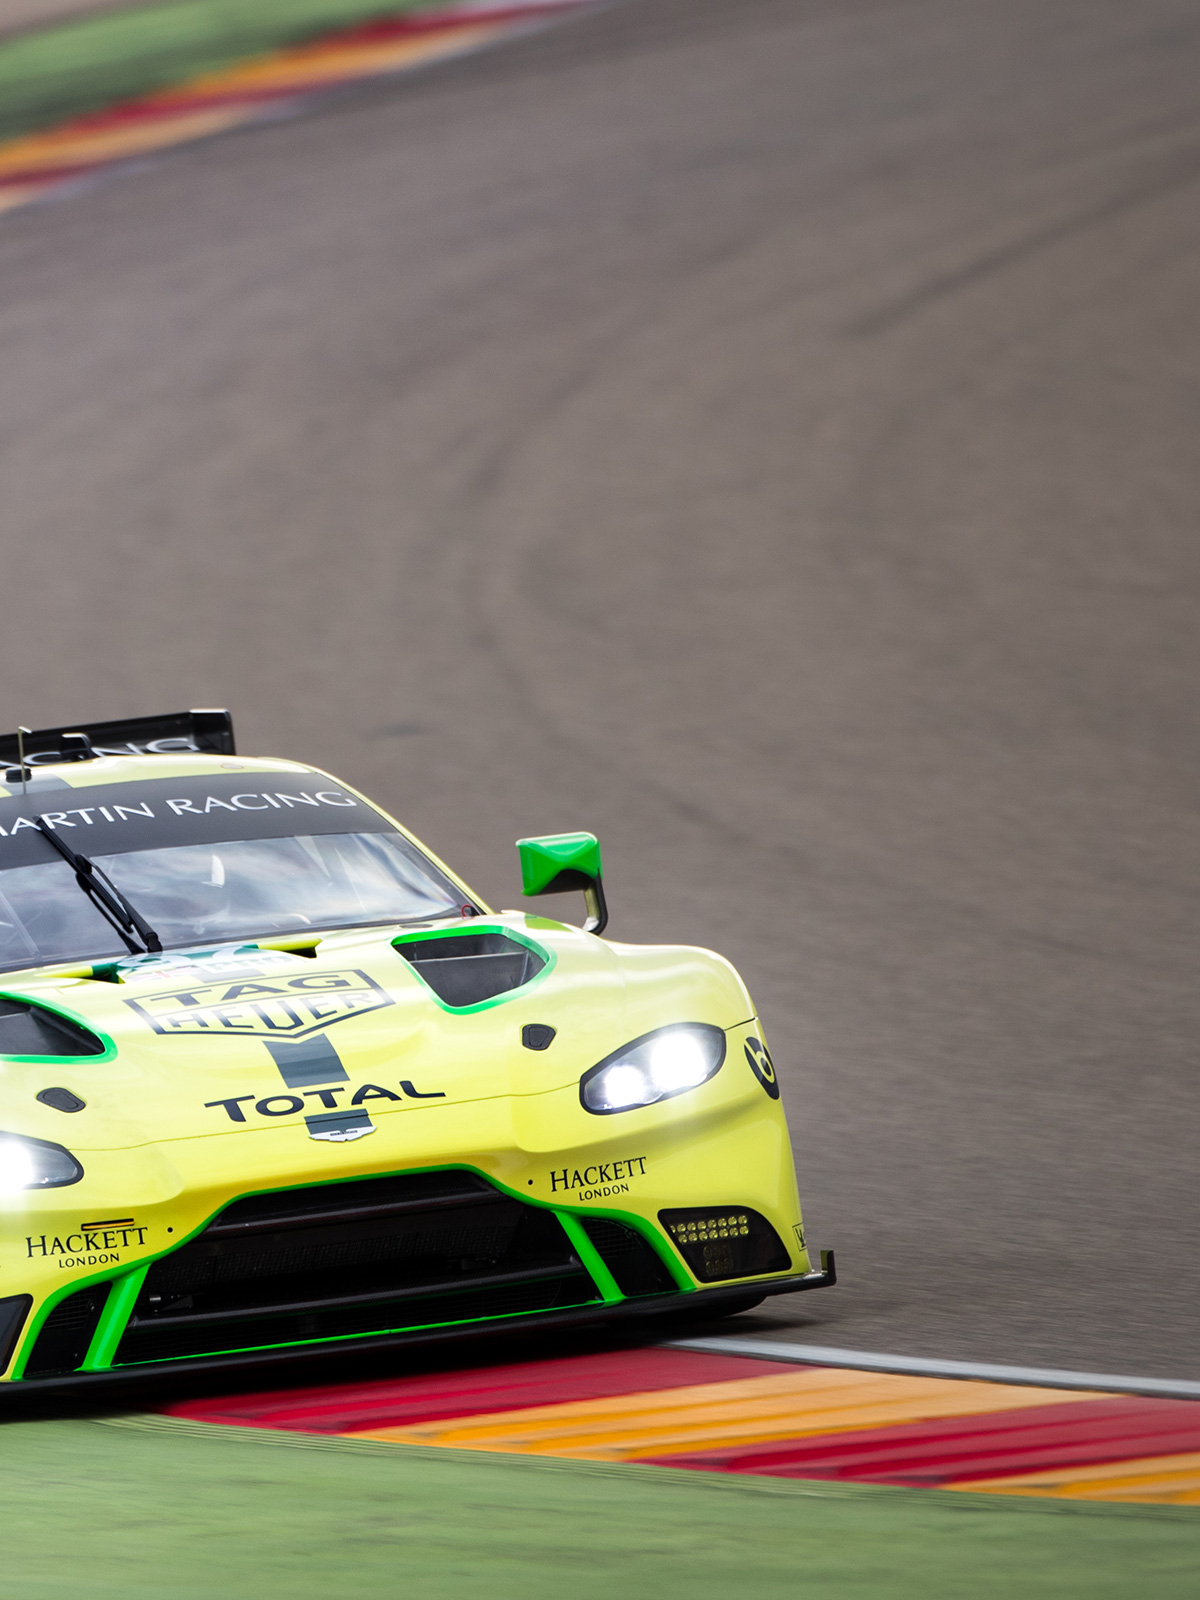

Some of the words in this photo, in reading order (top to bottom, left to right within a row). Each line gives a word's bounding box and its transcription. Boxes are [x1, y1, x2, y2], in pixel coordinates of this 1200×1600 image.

[166, 791, 357, 816] RACING
[150, 975, 352, 1007] TAG
[166, 992, 373, 1030] HEUER
[204, 1080, 446, 1123] TOTAL
[550, 1156, 647, 1192] HACKETT
[579, 1183, 629, 1201] LONDON
[25, 1227, 148, 1258] HACKETT
[59, 1253, 120, 1268] LONDON
